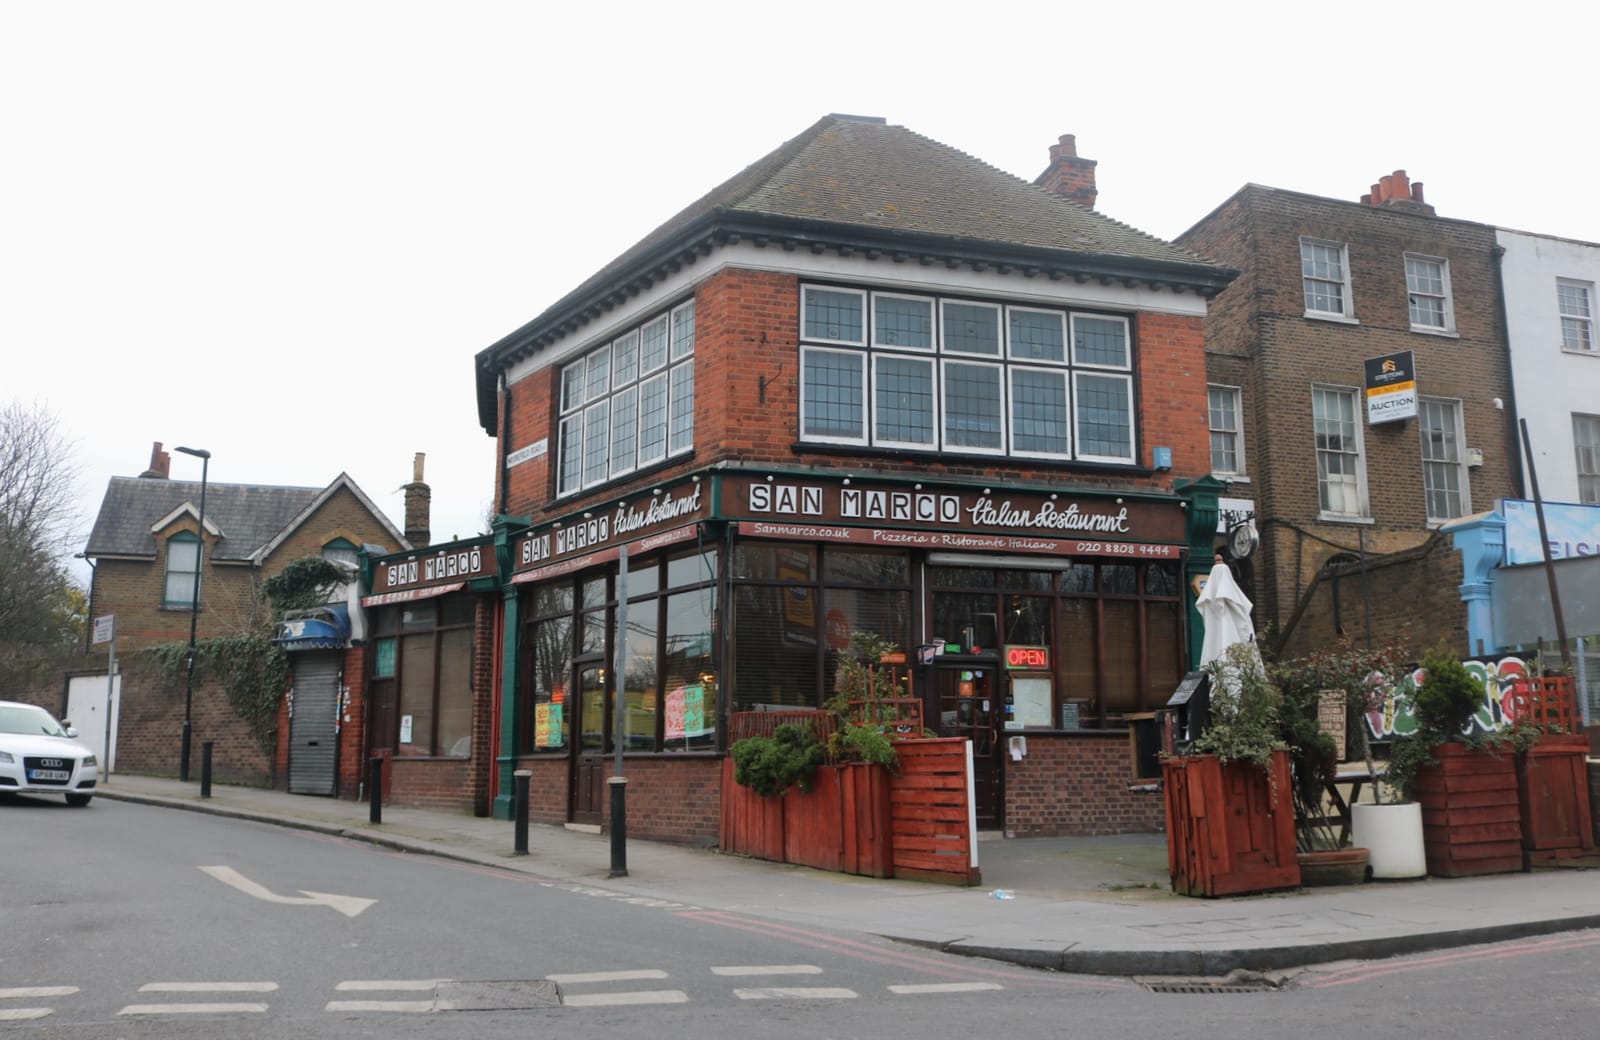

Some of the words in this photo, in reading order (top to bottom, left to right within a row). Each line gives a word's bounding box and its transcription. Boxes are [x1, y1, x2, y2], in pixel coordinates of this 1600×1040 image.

[1370, 397, 1414, 411] AUCTION
[751, 484, 822, 515] SAN
[841, 489, 959, 522] MARCO
[966, 497, 1030, 528] Italian
[1031, 501, 1129, 533] Restaurant
[523, 534, 550, 564] SAN
[556, 515, 609, 554] MARCO
[613, 506, 645, 536] Italian
[754, 522, 850, 538] Sanmarco.co.uk
[873, 529, 928, 544] Pizzeria
[942, 535, 1006, 547] Ristorante
[1008, 538, 1058, 550] Italiano
[1077, 543, 1101, 552] 020
[1105, 543, 1135, 554] 8808
[388, 561, 418, 586] SAN
[425, 550, 481, 580] MARCO
[1009, 648, 1045, 665] OPEN
